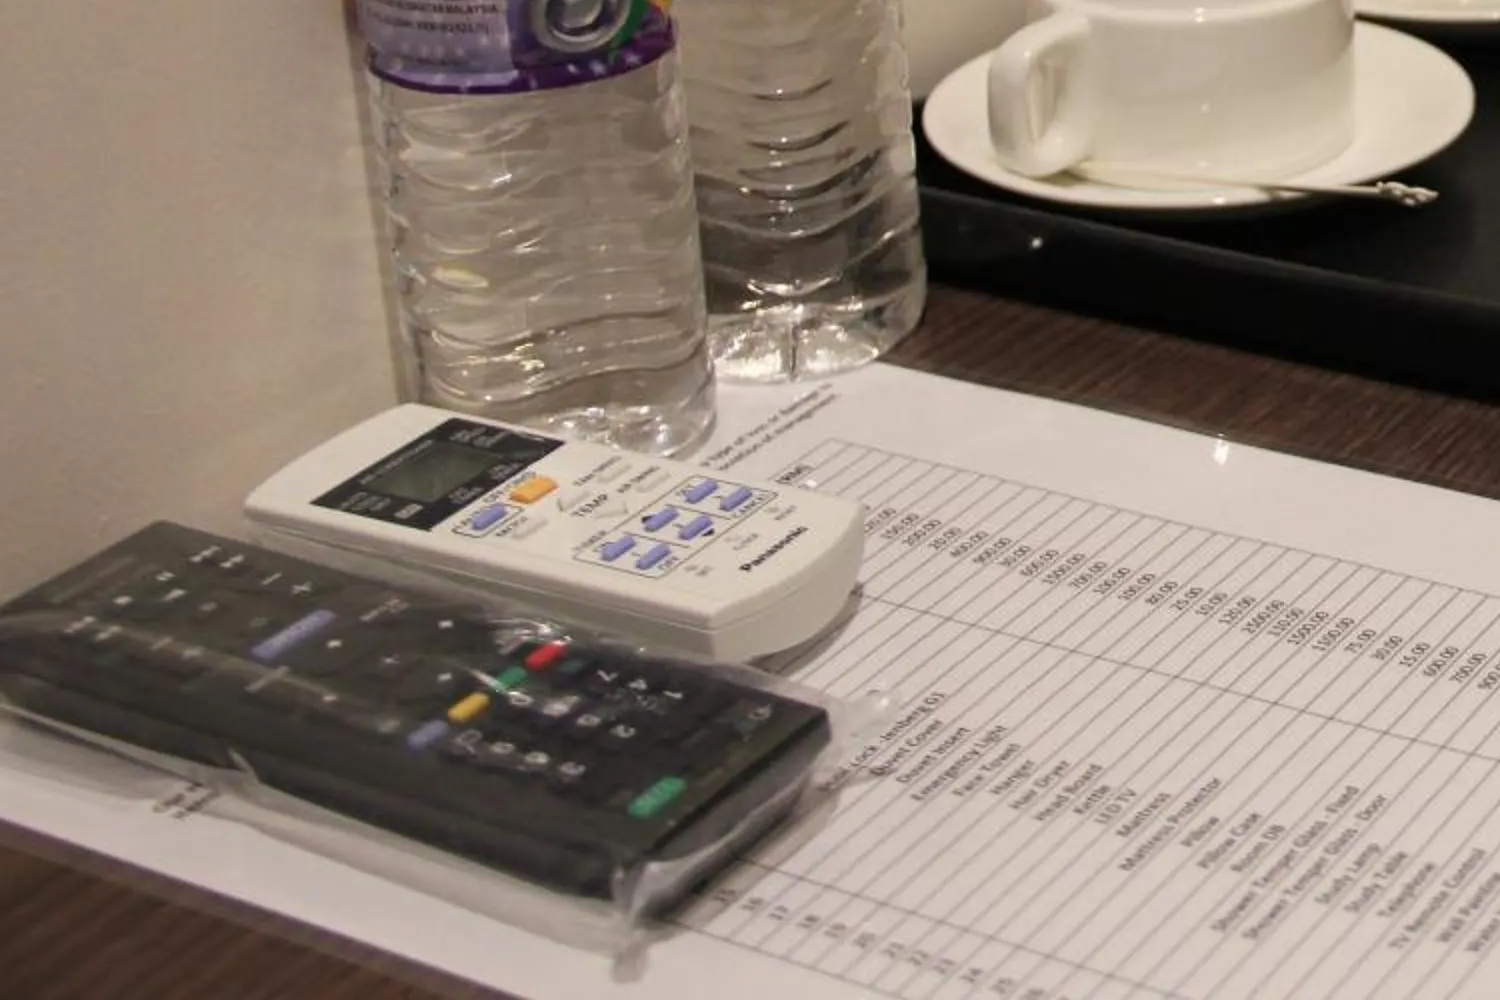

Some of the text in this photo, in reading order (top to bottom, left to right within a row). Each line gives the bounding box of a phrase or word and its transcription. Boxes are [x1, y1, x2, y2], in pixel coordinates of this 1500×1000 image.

[571, 493, 609, 518] TEMP
[738, 526, 809, 574] Panasonic
[1344, 629, 1376, 653] 75.00
[1399, 643, 1430, 667] 15.00
[905, 719, 943, 747] Cover
[896, 754, 937, 784] Duvet
[911, 724, 1007, 801] Emergency Light
[952, 743, 1021, 797] Face Towel
[989, 759, 1036, 795] Hanger
[1008, 760, 1070, 810] Hair Dryer
[1063, 763, 1103, 793] Board
[1115, 792, 1171, 837] Mattress
[1118, 788, 1137, 803] TV
[1118, 777, 1221, 871] Mattress Protector
[1230, 813, 1261, 837] Case
[1210, 891, 1256, 931] Shower
[1293, 821, 1328, 848] Glass
[1230, 841, 1269, 873] Room
[1242, 900, 1288, 939] Shower
[1324, 828, 1358, 855] Glass
[1355, 794, 1387, 822] Door
[1313, 843, 1380, 904] Study Lamp
[1344, 851, 1408, 912] Study Table
[1376, 862, 1436, 917] Telephone
[1388, 849, 1486, 949] TV Remote Control
